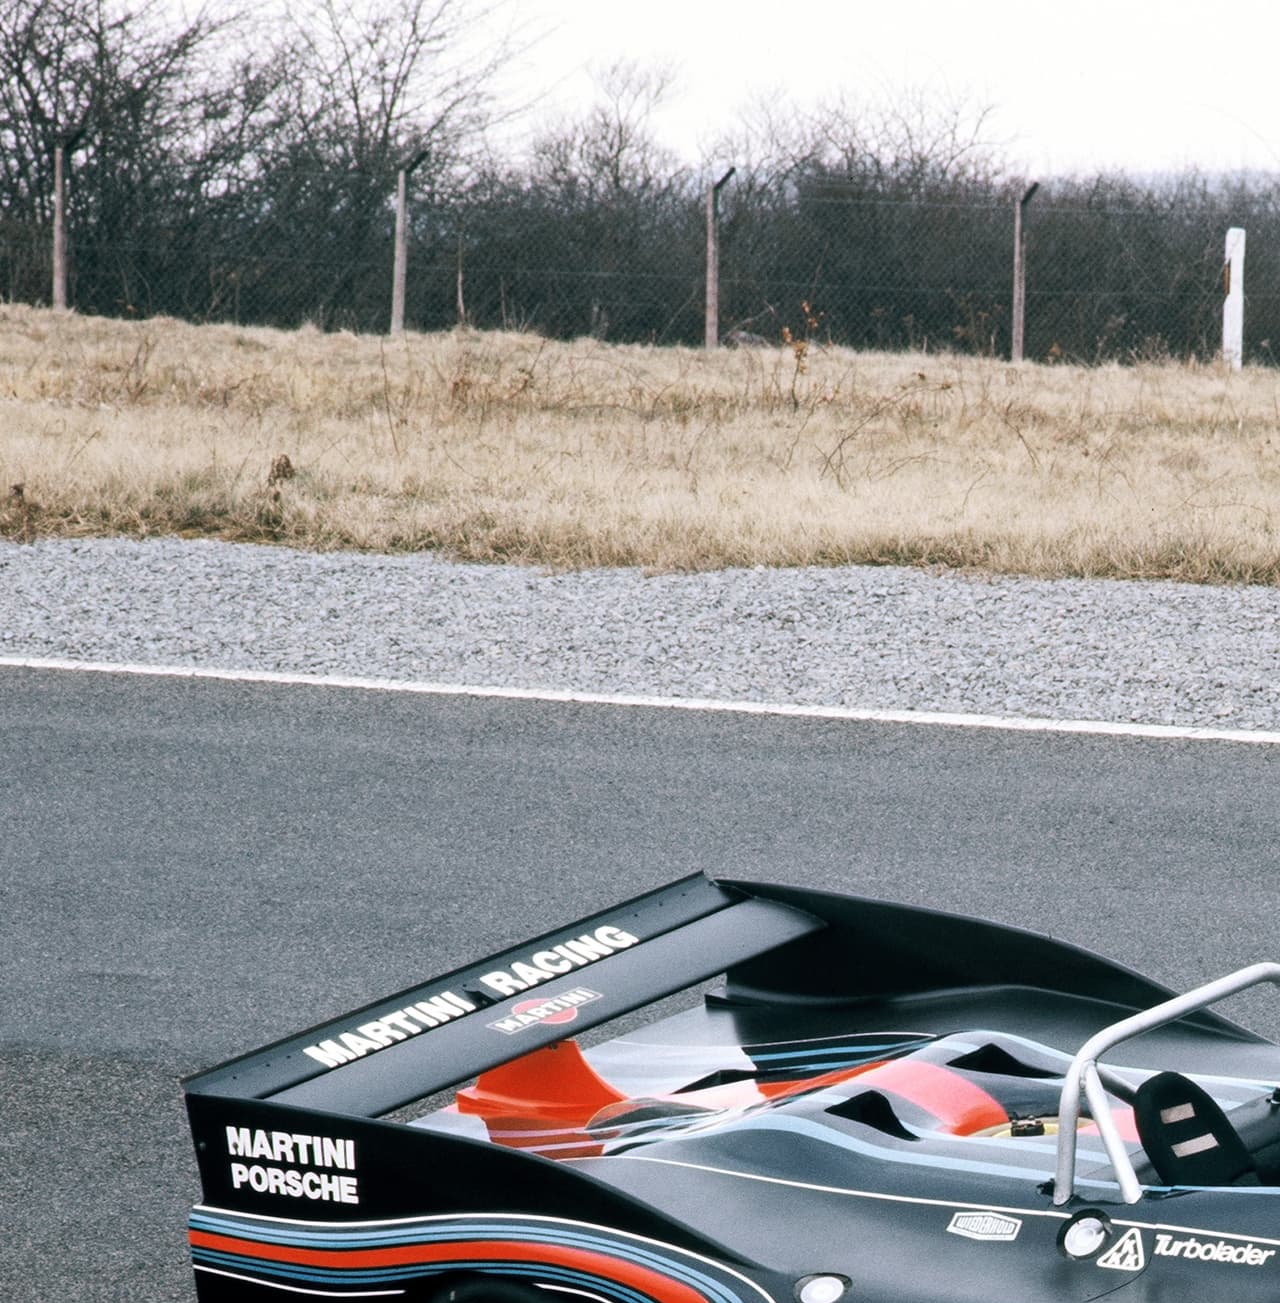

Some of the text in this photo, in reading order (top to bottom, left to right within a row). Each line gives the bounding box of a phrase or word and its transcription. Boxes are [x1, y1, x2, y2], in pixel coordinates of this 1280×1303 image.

[303, 925, 640, 1068] MARTINI RACING
[495, 989, 595, 1032] MARTINI
[225, 1126, 355, 1170] MARTINI
[231, 1162, 359, 1204] PORSCHE
[1153, 1234, 1276, 1266] Turbolader
